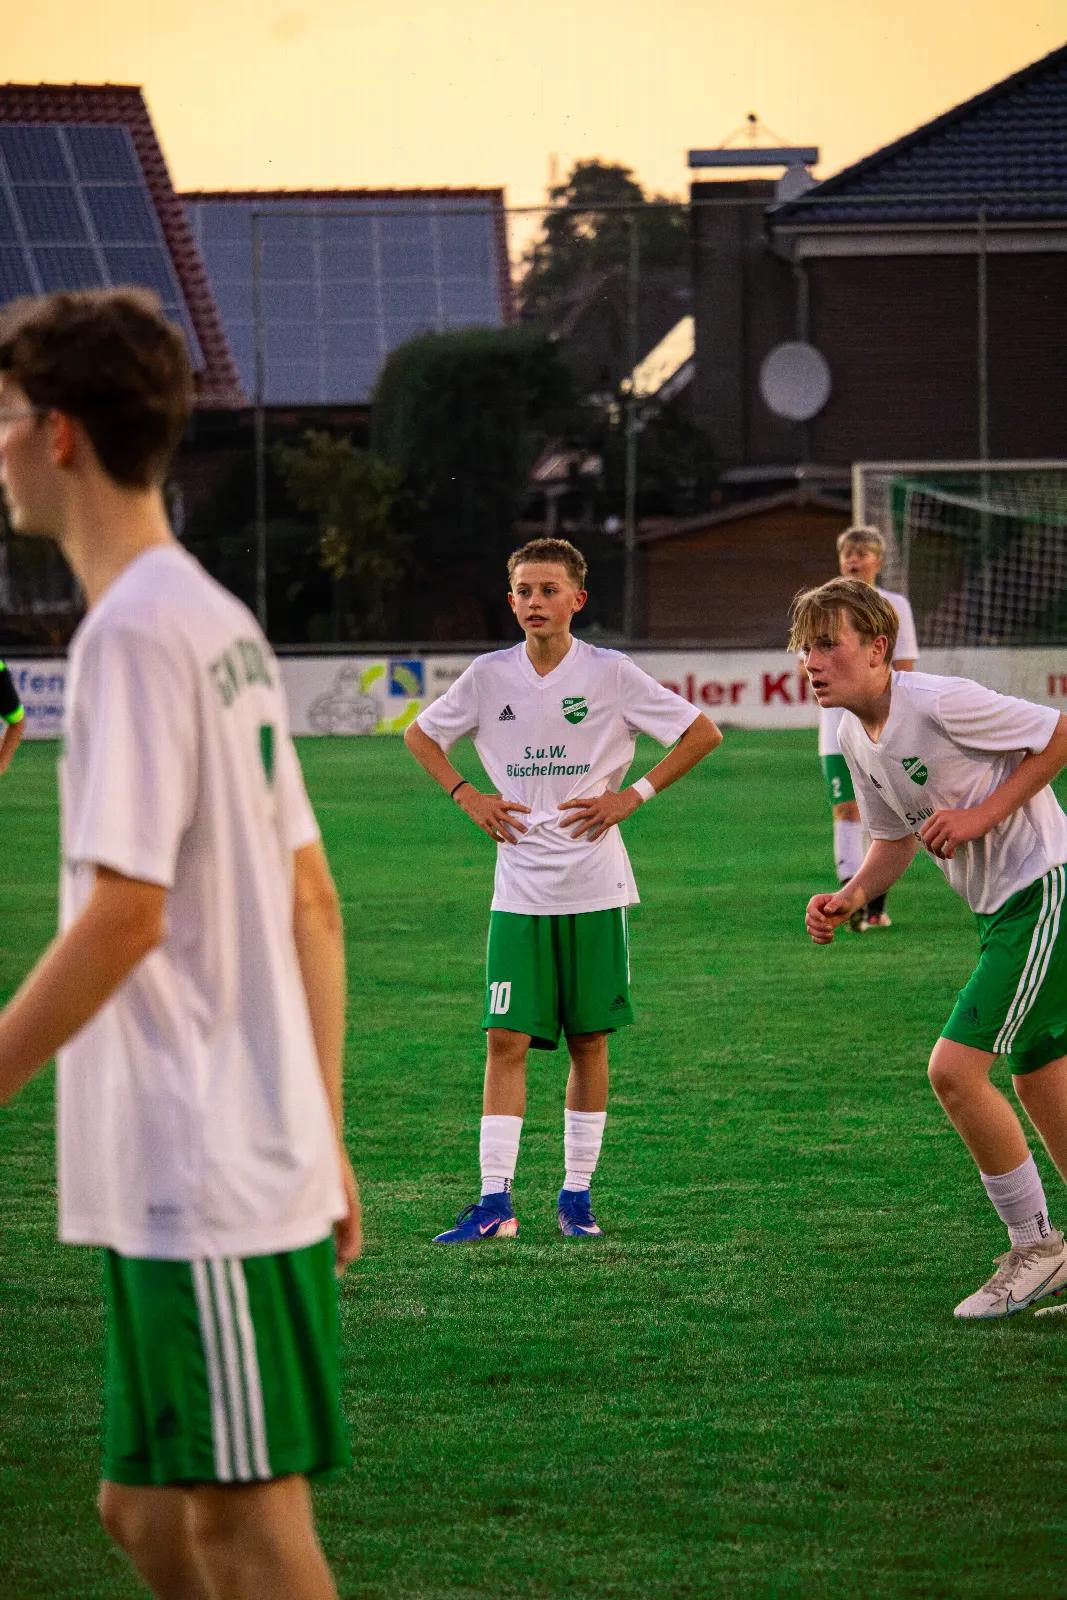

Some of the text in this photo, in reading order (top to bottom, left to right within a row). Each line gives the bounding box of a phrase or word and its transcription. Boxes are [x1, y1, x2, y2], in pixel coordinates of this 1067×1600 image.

[524, 745, 566, 759] S.u.W.
[507, 762, 590, 777] Büschelmann
[489, 981, 512, 1015] 10
